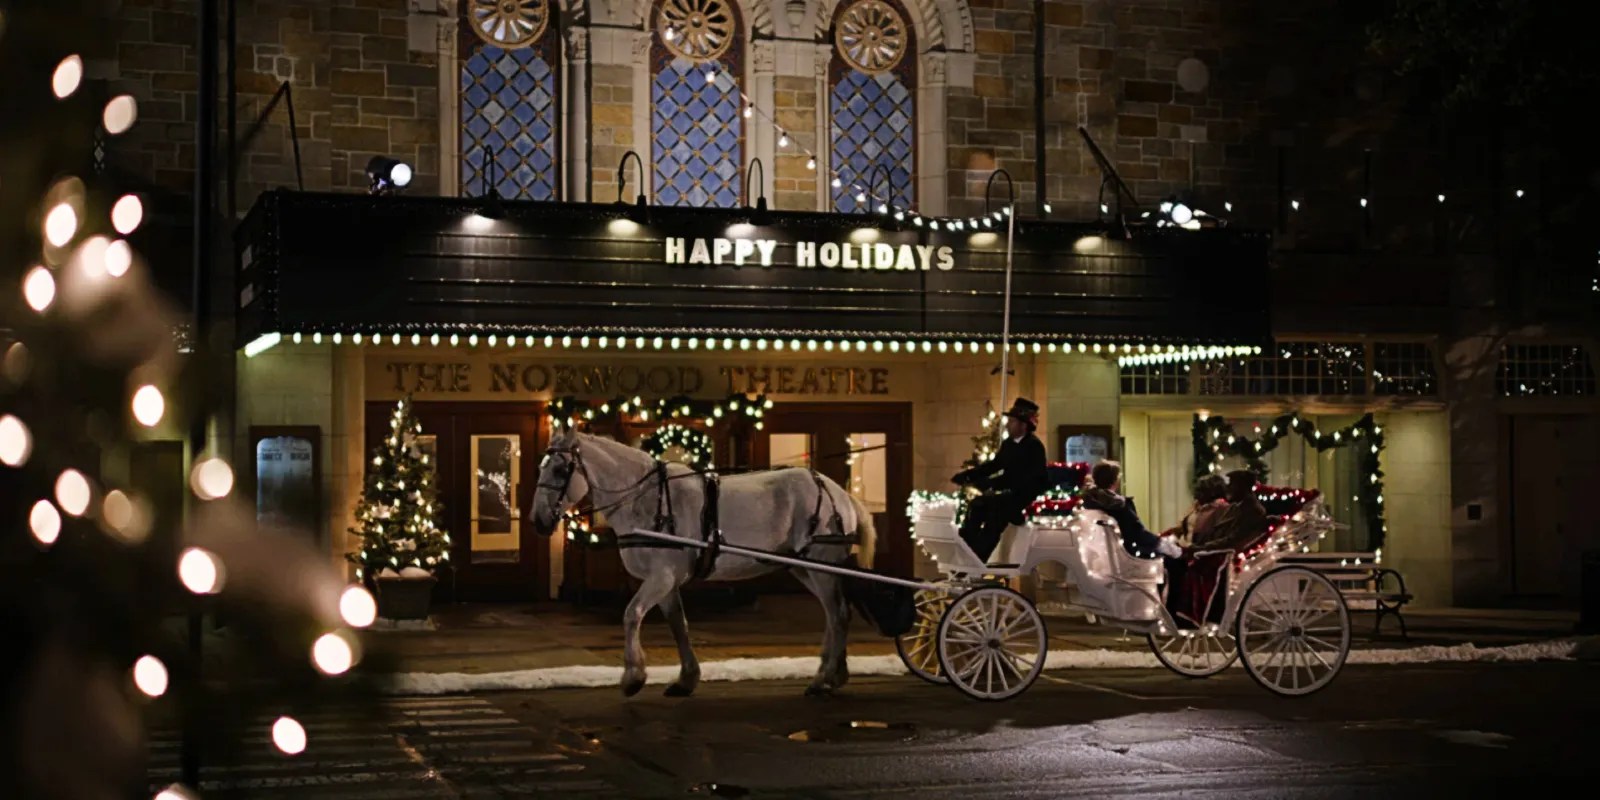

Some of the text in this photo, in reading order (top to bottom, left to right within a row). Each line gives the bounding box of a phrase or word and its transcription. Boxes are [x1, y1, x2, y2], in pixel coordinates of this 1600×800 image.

[665, 237, 955, 271] HAPPY HOLIDAYS
[386, 362, 889, 395] THE NORWOOD THEATRE
